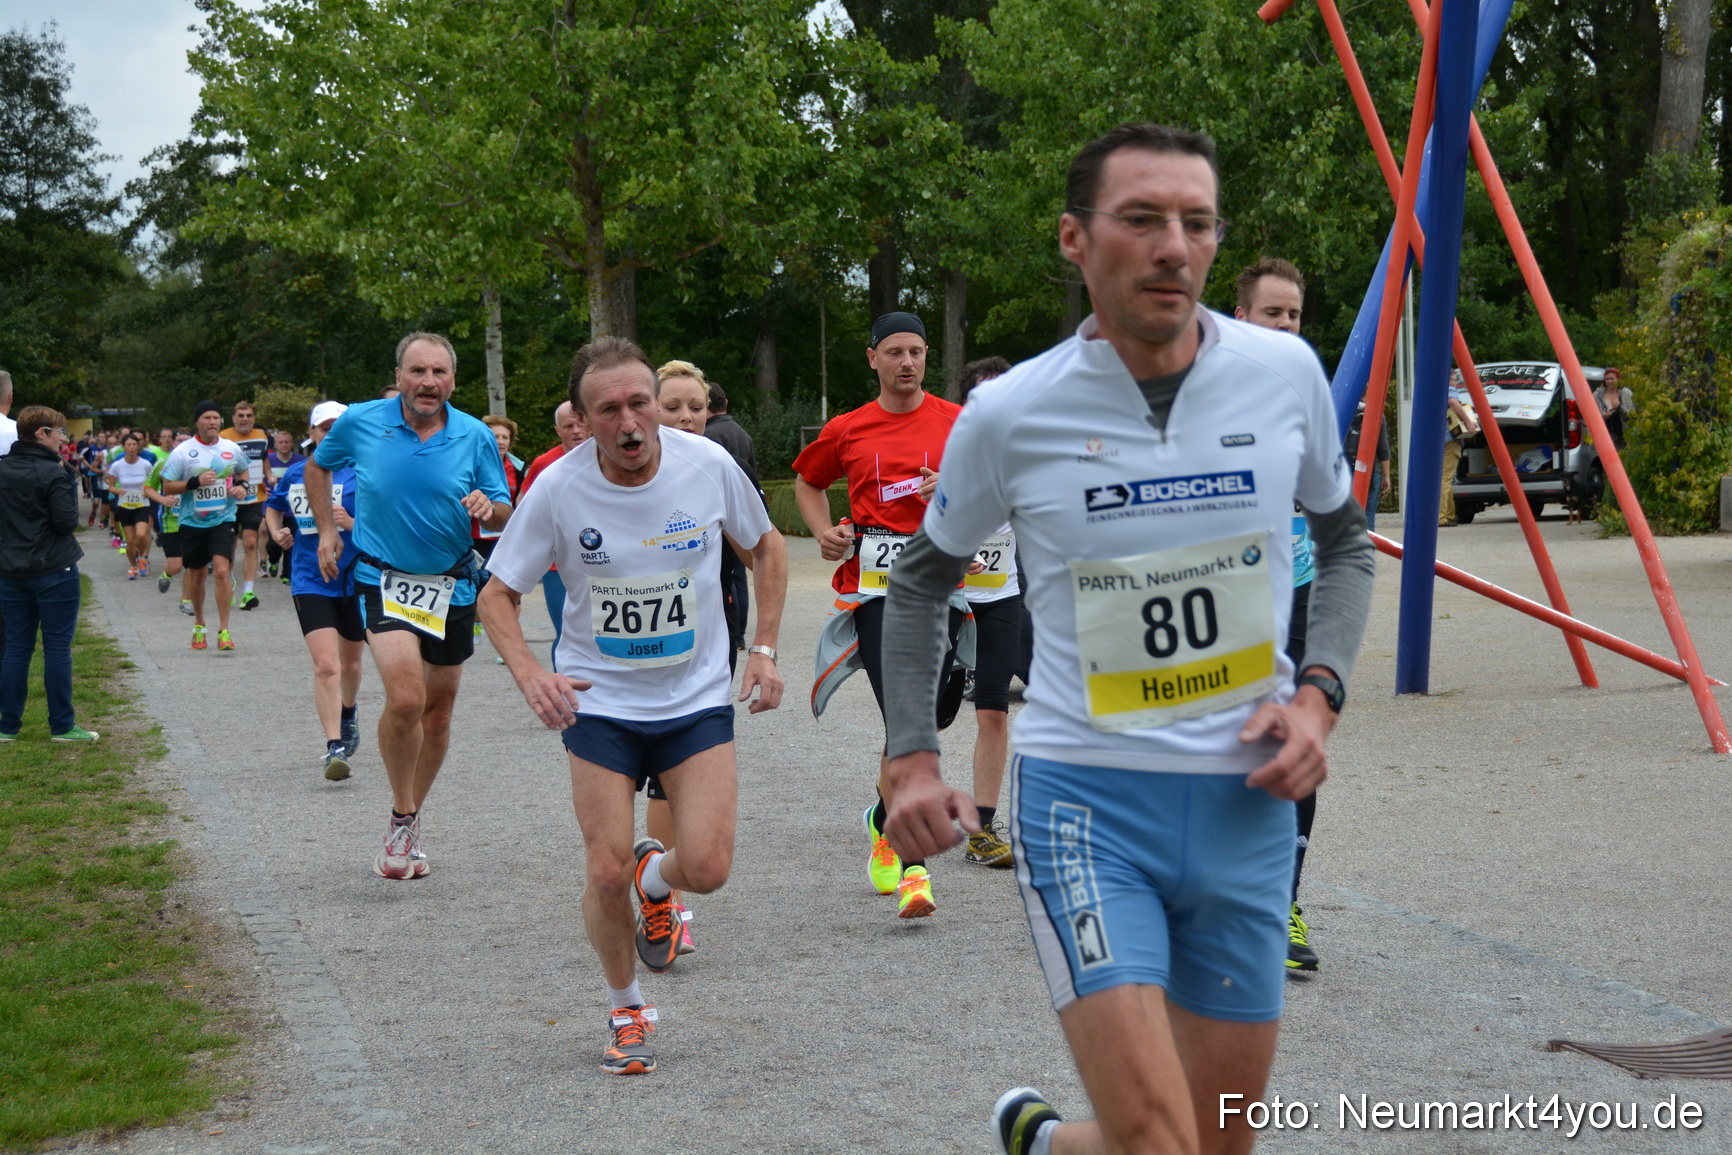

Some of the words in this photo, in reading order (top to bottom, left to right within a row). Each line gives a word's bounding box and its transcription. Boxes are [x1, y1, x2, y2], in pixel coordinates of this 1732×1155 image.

[197, 486, 225, 500] 3040
[893, 483, 913, 495] DEHN
[1139, 475, 1252, 502] BÜSCHEL
[127, 494, 140, 503] 125
[1193, 499, 1258, 513] WERKZEUGBAU
[580, 551, 610, 560] PARTL
[583, 558, 611, 566] Neumarkt
[1078, 574, 1142, 592] PARTL
[1146, 556, 1236, 587] Neumarkt
[395, 581, 440, 611] 327
[591, 584, 623, 596] PARTL
[625, 582, 675, 596] Neumarkt
[400, 606, 431, 626] Thomas
[601, 594, 687, 634] 2674
[1141, 587, 1219, 659] 80
[627, 640, 664, 656] Josef
[1141, 664, 1230, 702] Helmut
